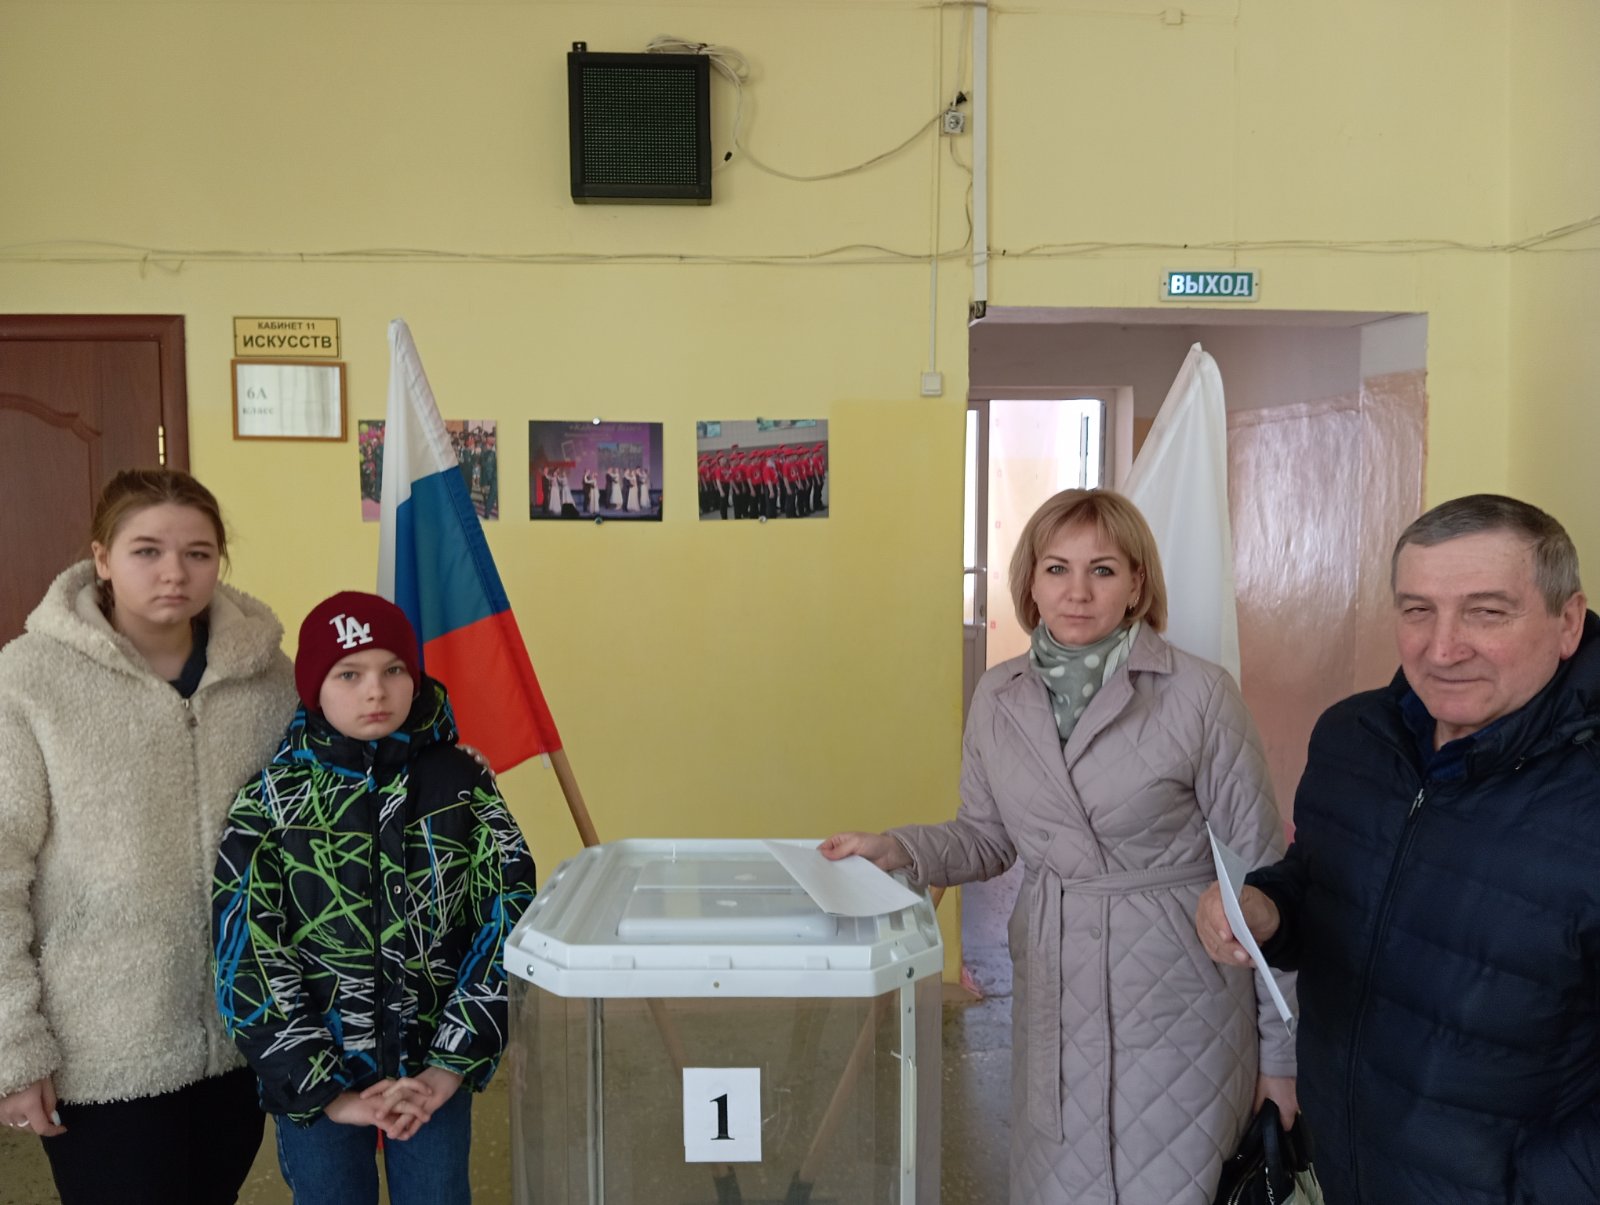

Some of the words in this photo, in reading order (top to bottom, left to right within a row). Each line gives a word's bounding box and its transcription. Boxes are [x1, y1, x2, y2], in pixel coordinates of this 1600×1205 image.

[1170, 274, 1249, 296] ВЫХОД
[257, 321, 303, 330] КАБИНЕТ
[306, 322, 316, 330] 11
[243, 335, 332, 348] ИСКУССТВ
[246, 386, 268, 400] 6А
[329, 613, 374, 650] LA
[709, 1093, 736, 1141] 1
